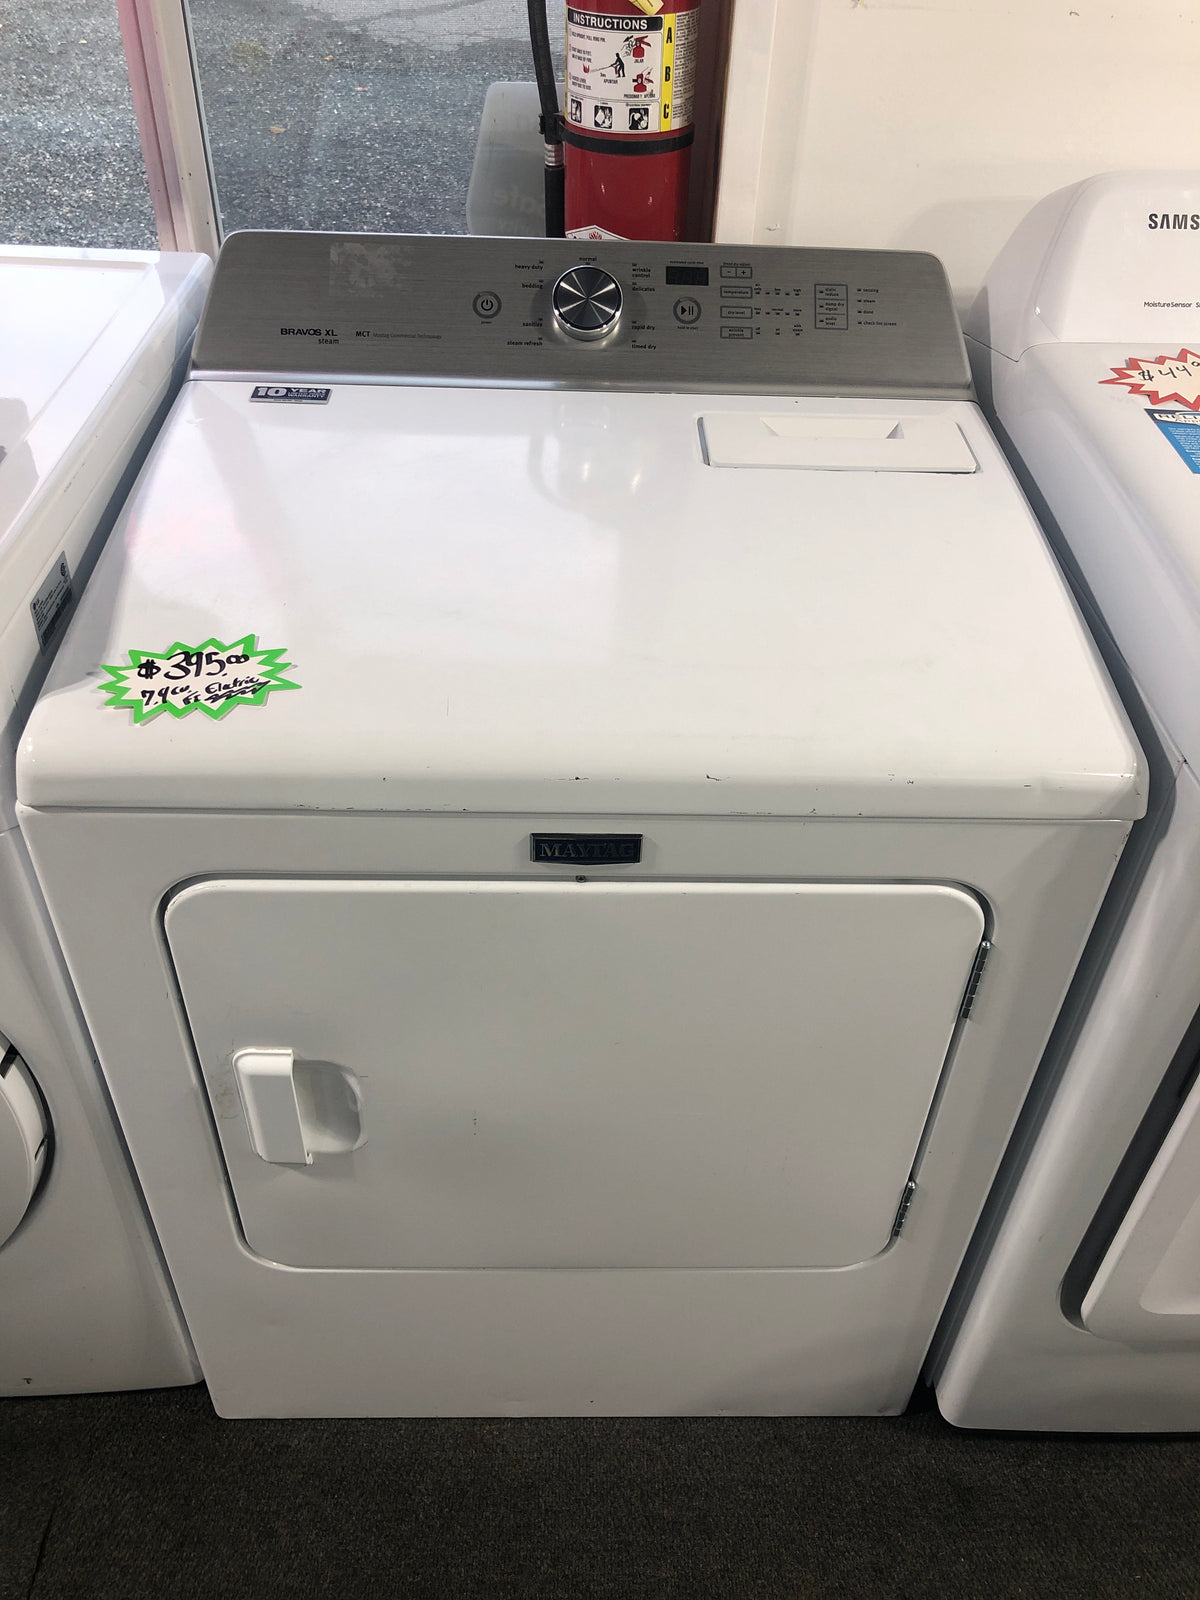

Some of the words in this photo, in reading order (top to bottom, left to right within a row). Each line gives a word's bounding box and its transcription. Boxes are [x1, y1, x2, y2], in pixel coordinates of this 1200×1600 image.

[573, 12, 648, 30] INSTRUCTIONS
[666, 26, 672, 44] A
[664, 66, 671, 82] B
[663, 104, 670, 119] C
[1148, 213, 1200, 230] SAMS
[280, 328, 322, 336] BRAVOS
[258, 387, 287, 397] 10
[539, 843, 634, 858] MAYTAG
